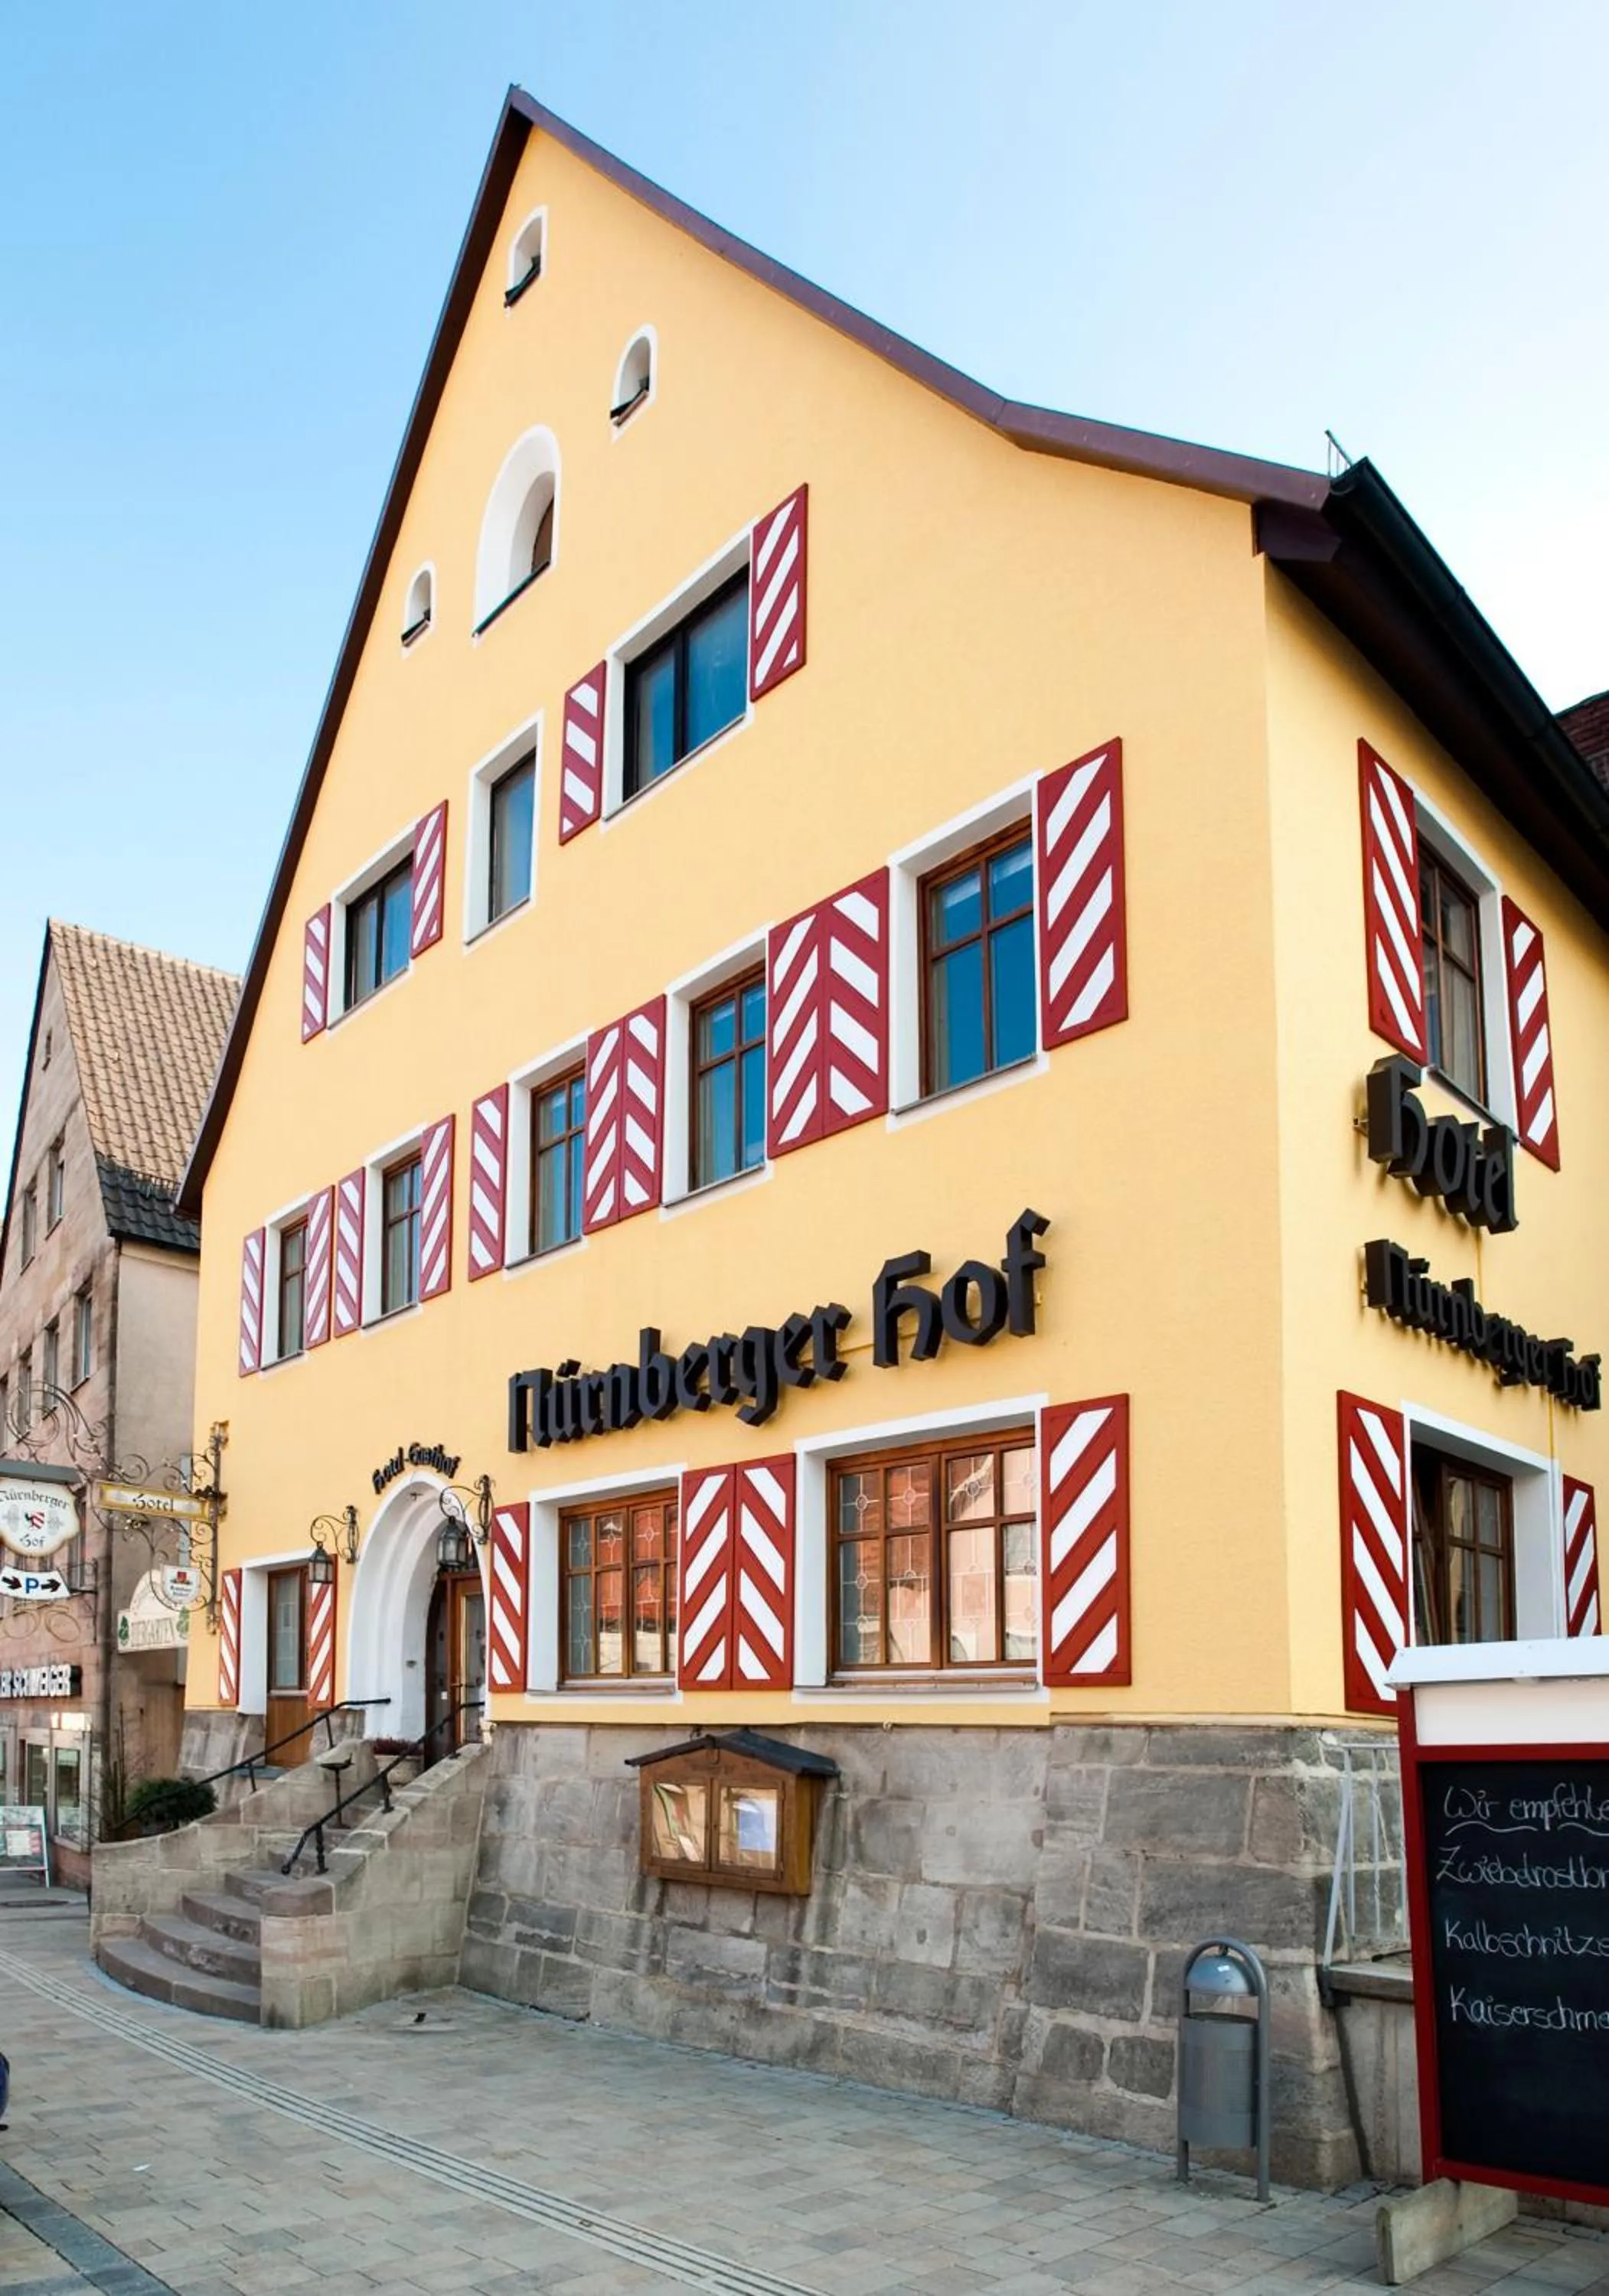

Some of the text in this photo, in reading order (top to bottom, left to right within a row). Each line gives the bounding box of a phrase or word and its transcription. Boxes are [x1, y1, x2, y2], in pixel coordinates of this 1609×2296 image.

[508, 1207, 1050, 1454] Nürnberger Hof
[132, 1493, 174, 1512] Hotel
[19, 1533, 46, 1548] Hof
[25, 1577, 39, 1594] P
[1444, 1786, 1500, 1820] Wir
